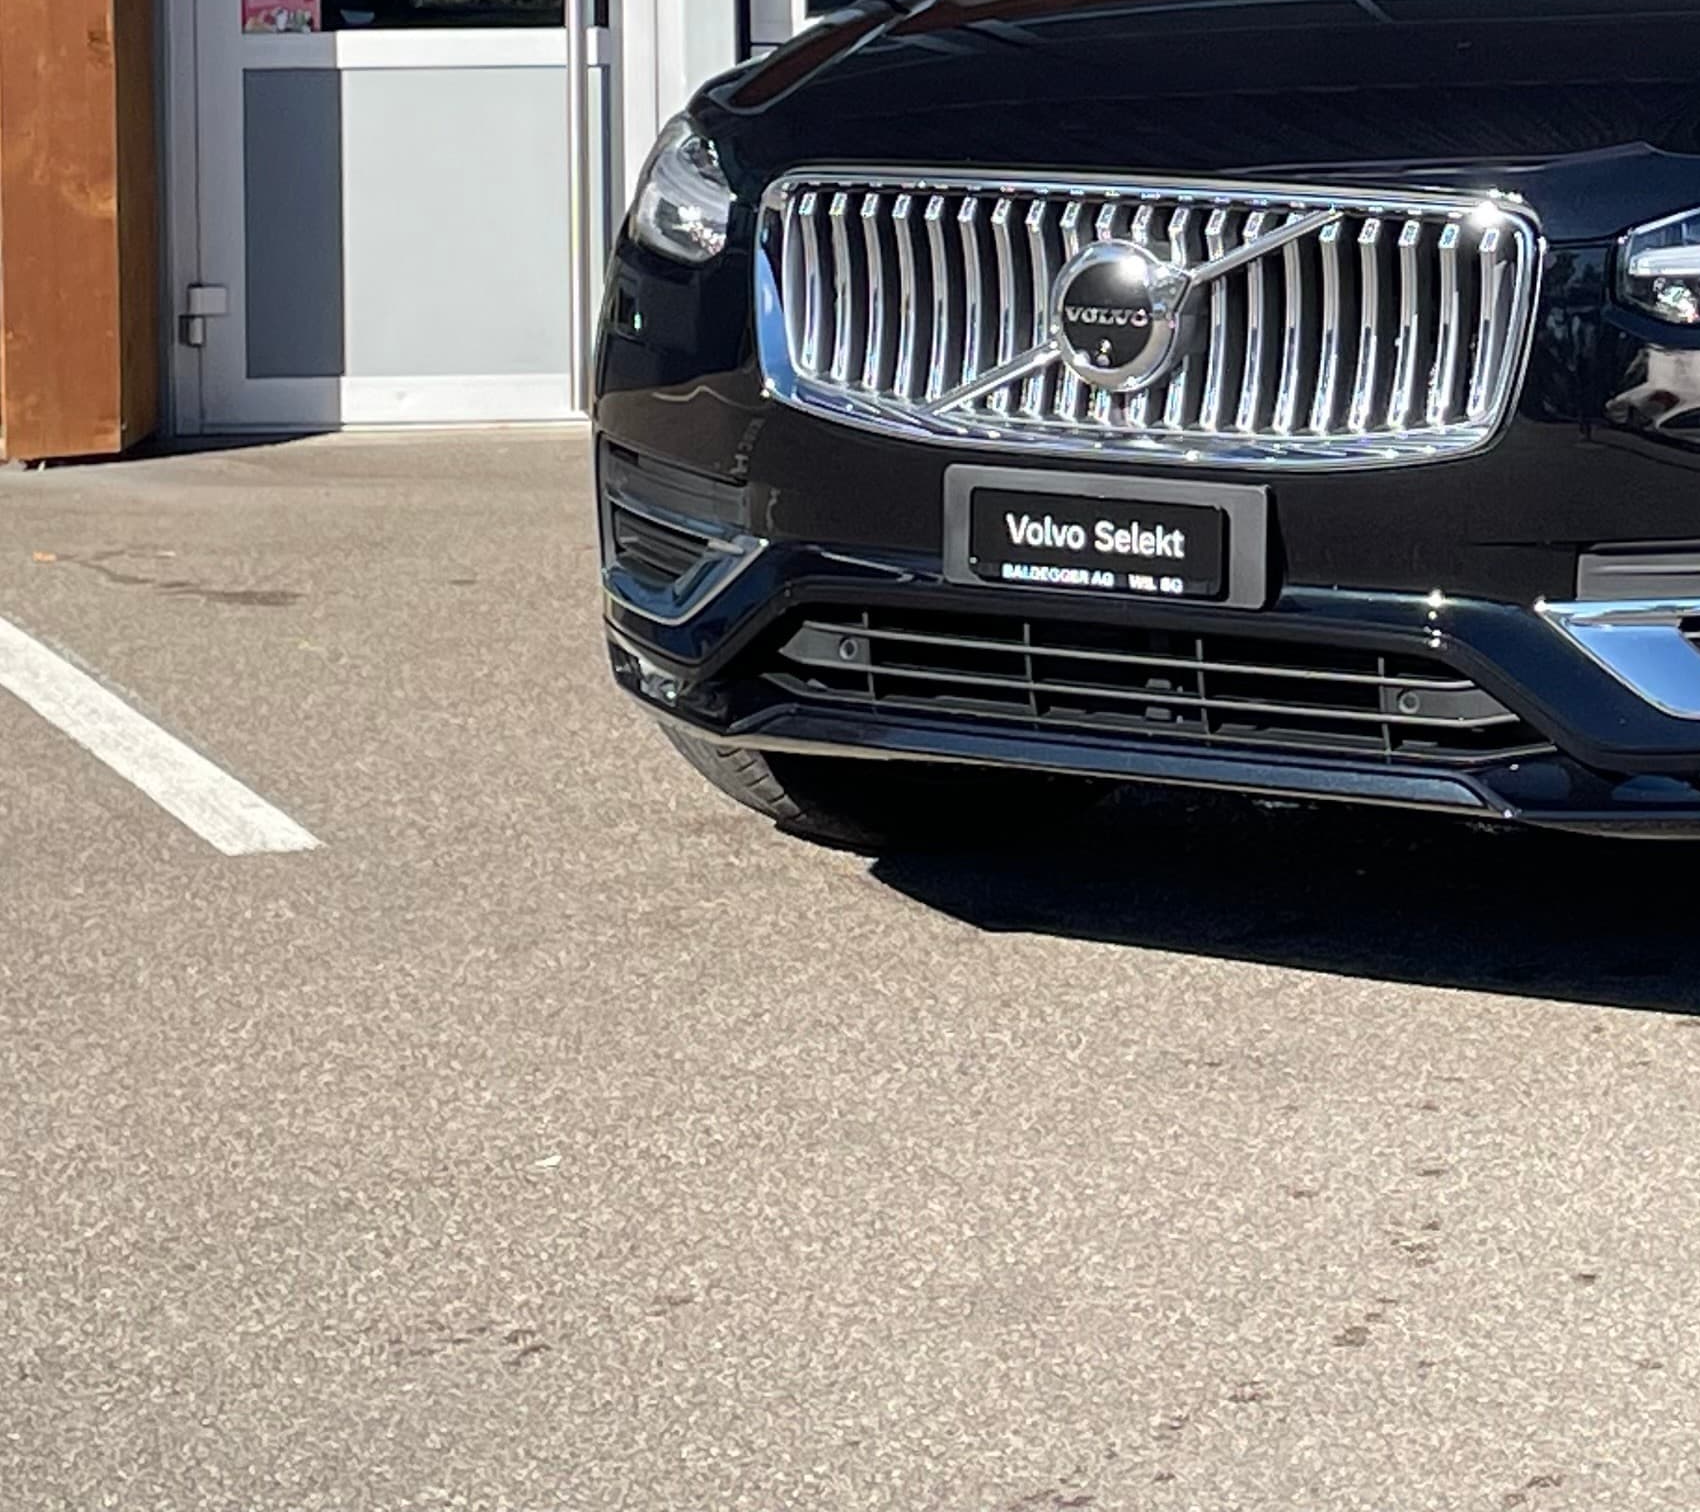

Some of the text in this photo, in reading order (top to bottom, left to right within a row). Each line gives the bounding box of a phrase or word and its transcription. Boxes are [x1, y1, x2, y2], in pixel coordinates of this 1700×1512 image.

[1064, 305, 1149, 328] VOLVO
[1005, 513, 1186, 559] Volvo Selekt
[1001, 562, 1090, 585] BALDEGGER
[1091, 569, 1116, 588] AG
